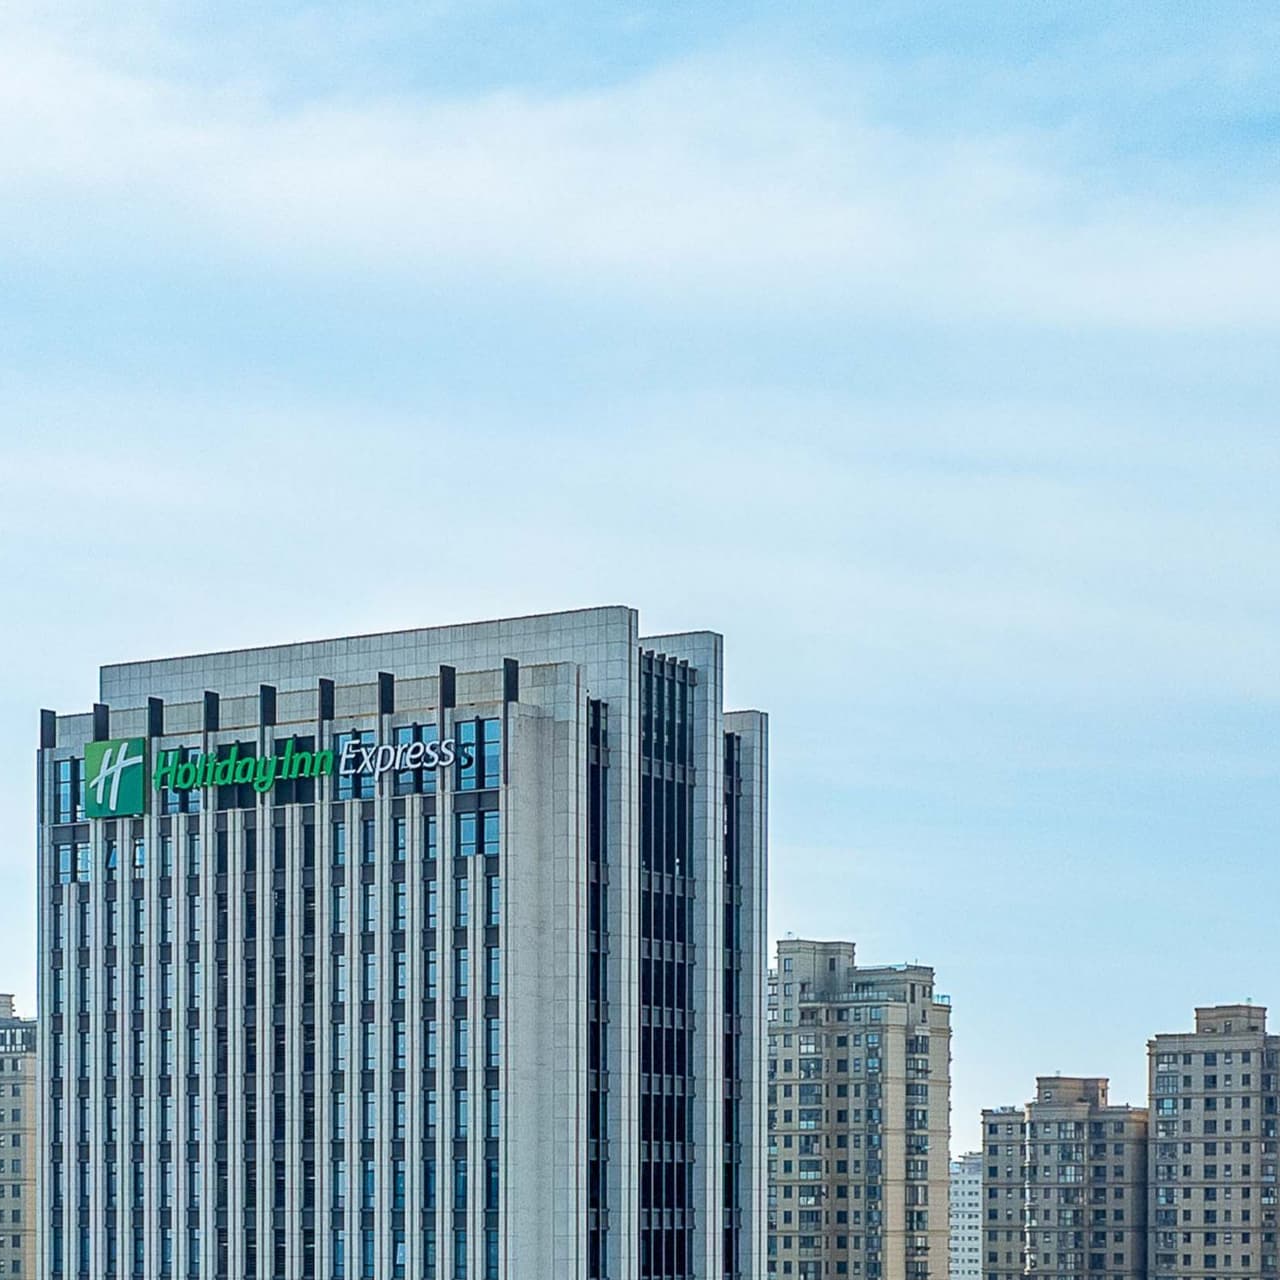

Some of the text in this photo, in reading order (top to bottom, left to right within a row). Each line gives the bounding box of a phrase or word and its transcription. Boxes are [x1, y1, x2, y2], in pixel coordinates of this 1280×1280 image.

[153, 739, 456, 793] Holiday Inn Express
